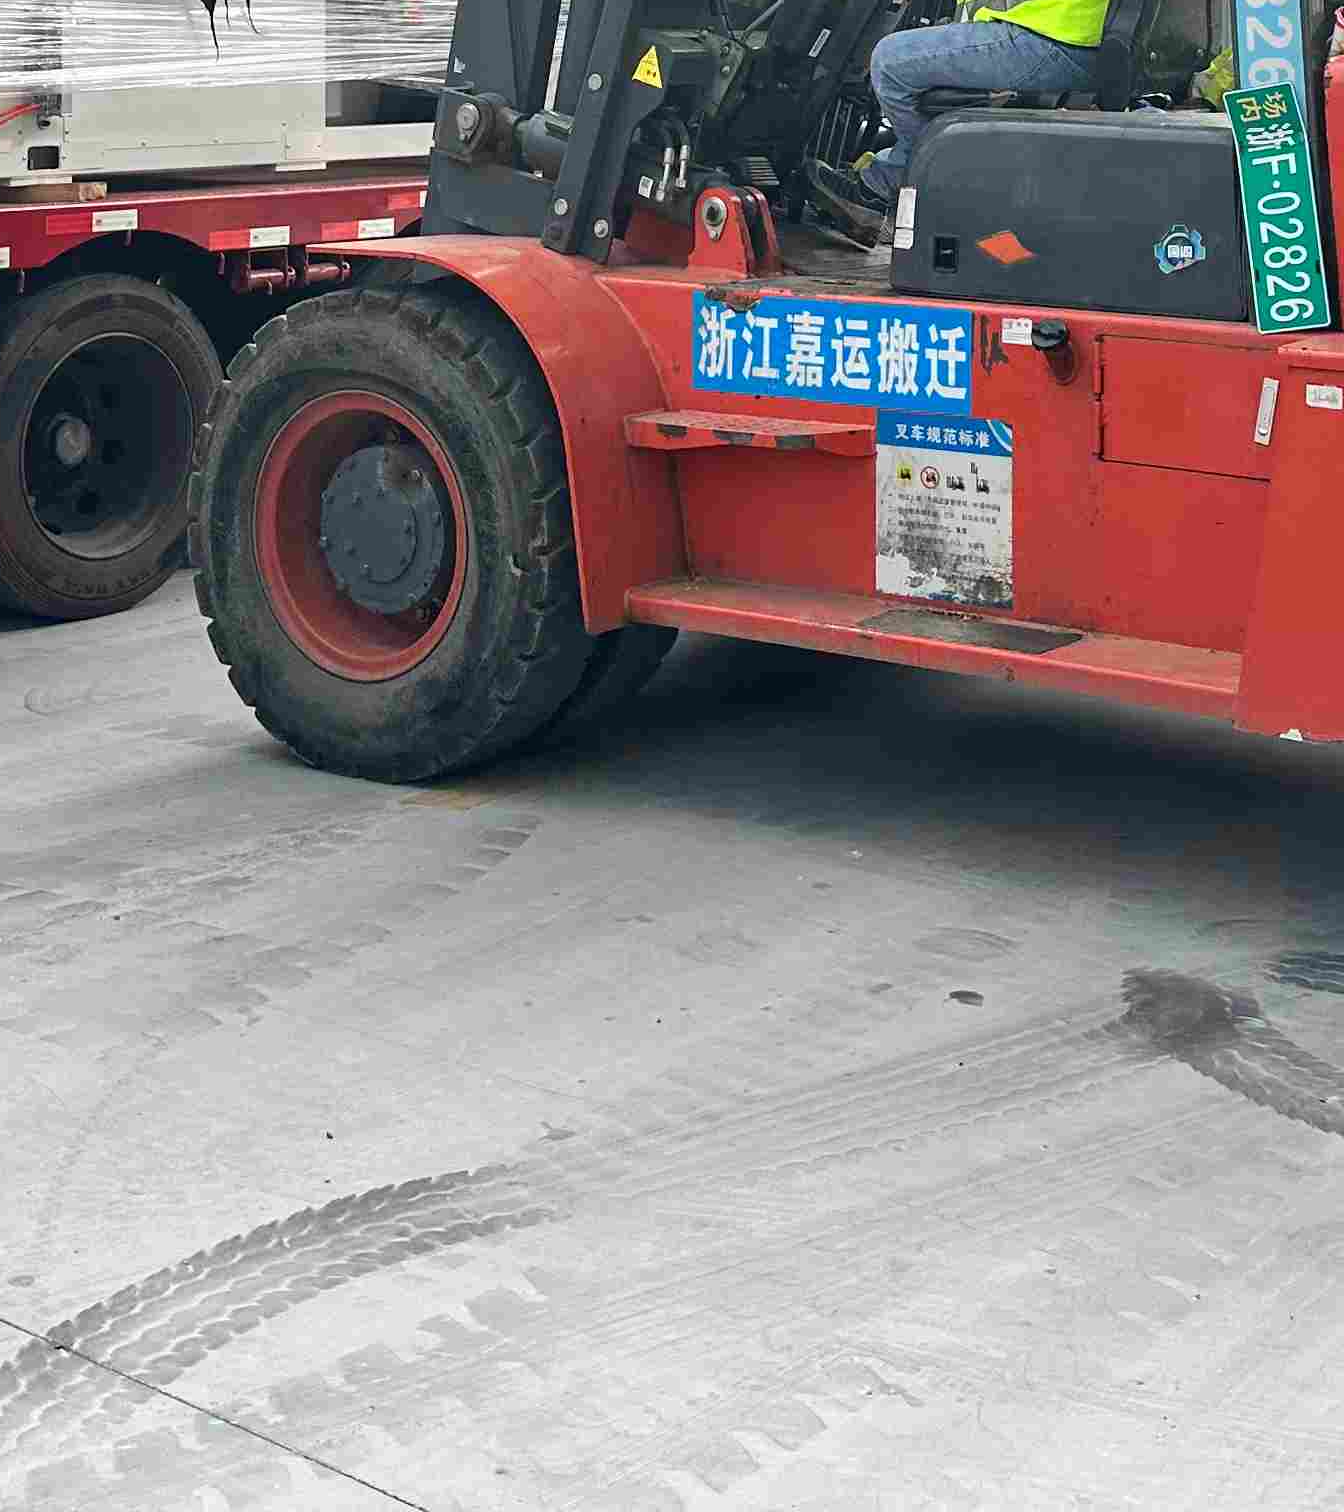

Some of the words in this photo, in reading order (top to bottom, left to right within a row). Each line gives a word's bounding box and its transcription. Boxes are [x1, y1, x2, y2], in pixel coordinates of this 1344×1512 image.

[1236, 91, 1288, 122] 场内
[1245, 122, 1315, 324] 浙F·02826
[697, 305, 968, 400] 浙江嘉运搬迁
[895, 422, 991, 449] 叉车规范标准
